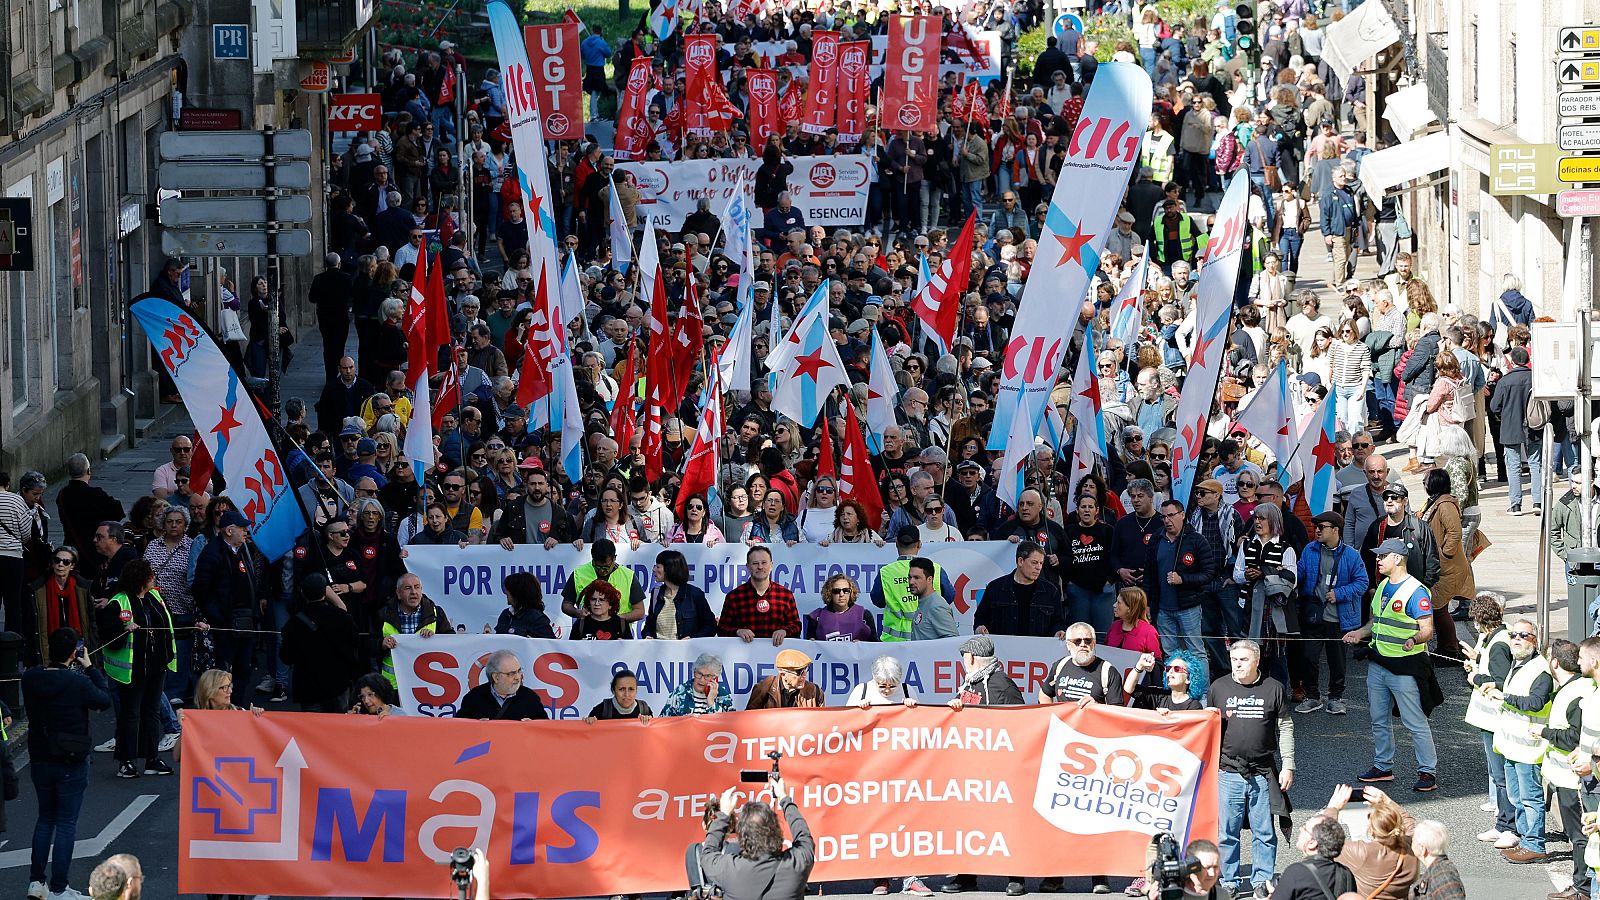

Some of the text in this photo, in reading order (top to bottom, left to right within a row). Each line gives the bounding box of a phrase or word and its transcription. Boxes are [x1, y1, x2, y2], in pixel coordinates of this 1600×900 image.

[218, 29, 243, 46] PR
[541, 28, 566, 111] UGT
[902, 18, 926, 102] UGT
[328, 104, 375, 120] KFC
[1574, 138, 1600, 146] PALACIO
[1561, 166, 1592, 174] oficinas
[443, 565, 493, 596] POR
[871, 726, 1014, 753] PRIMARIA
[1059, 741, 1184, 798] SOS
[802, 778, 1014, 809] HOSPITALARIA
[1056, 771, 1178, 813] sanidade
[1050, 792, 1173, 832] pública
[869, 825, 1011, 862] PÚBLICA
